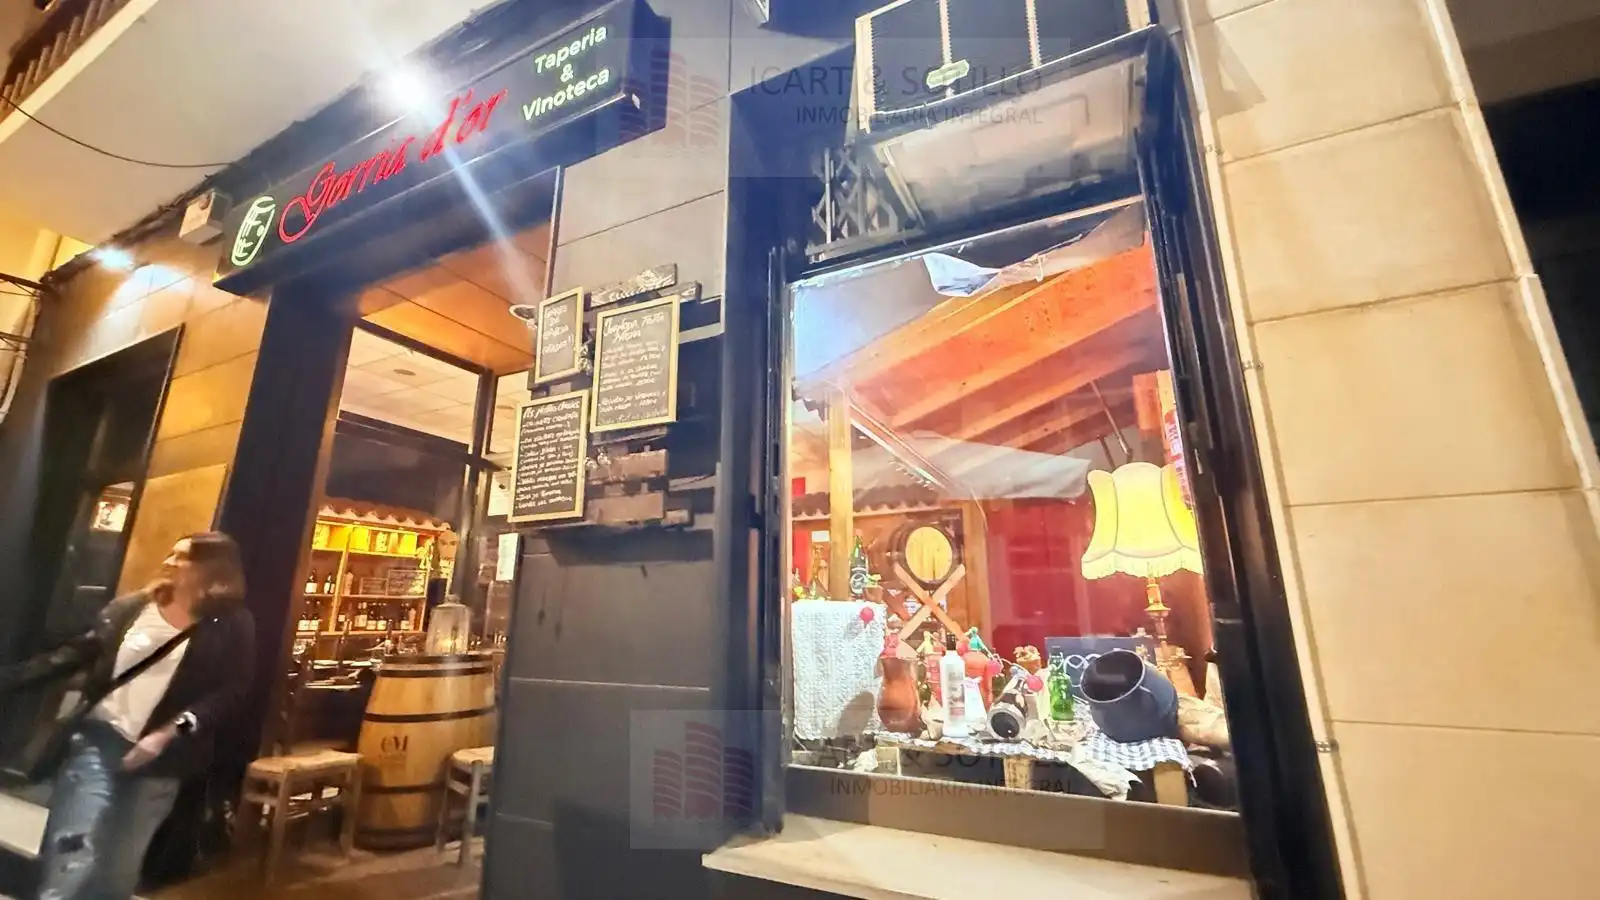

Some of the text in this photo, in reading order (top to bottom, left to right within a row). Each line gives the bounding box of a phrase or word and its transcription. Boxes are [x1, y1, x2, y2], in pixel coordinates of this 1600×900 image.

[534, 26, 607, 73] Taperia
[560, 63, 574, 82] &
[522, 69, 610, 121] Vinoteca
